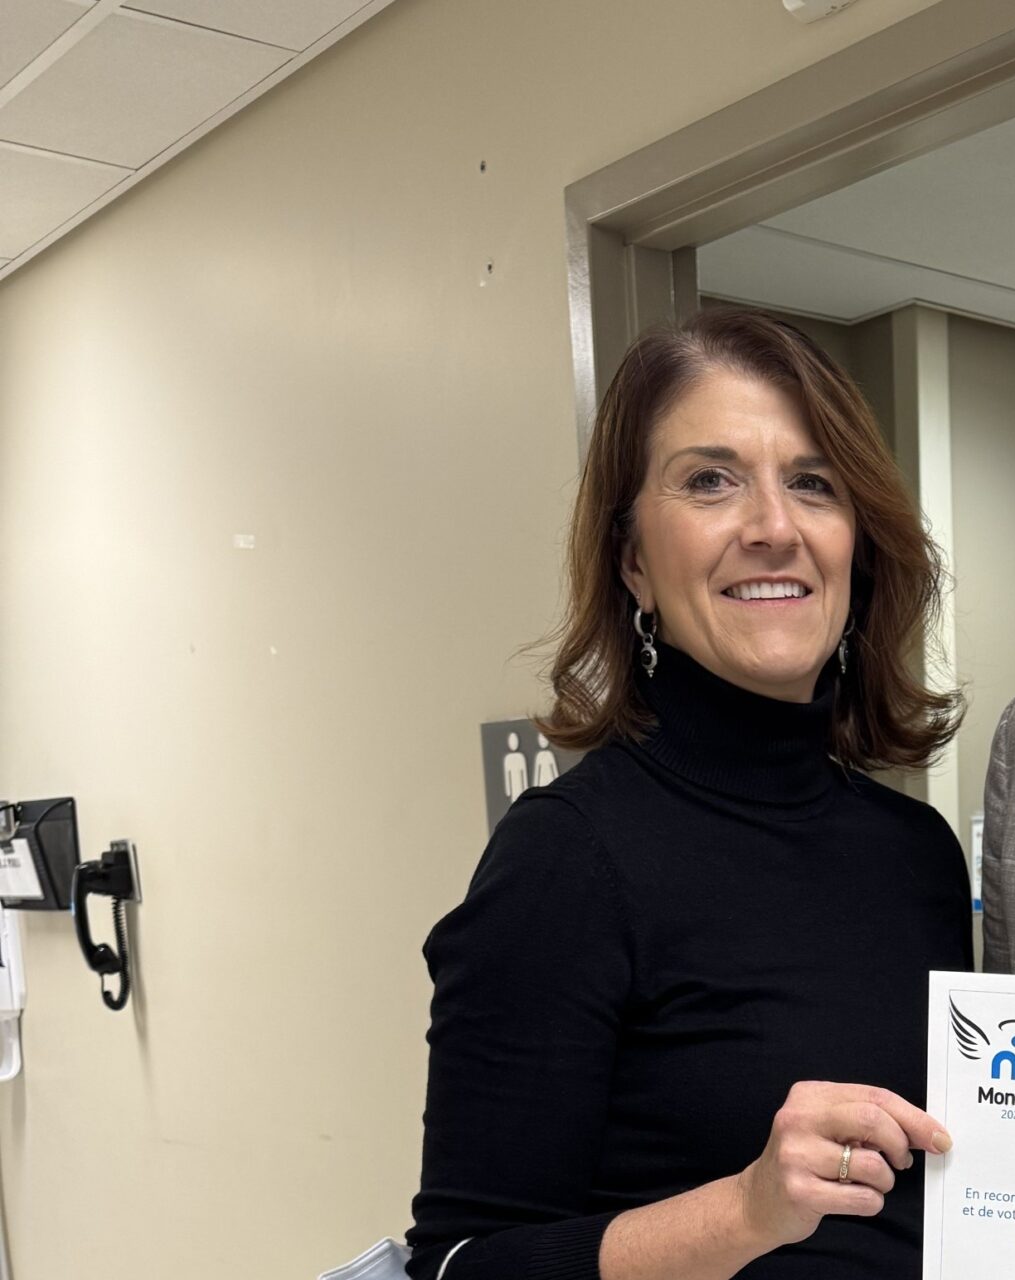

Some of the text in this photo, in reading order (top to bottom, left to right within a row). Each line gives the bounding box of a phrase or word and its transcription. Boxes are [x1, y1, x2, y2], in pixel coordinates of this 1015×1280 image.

[965, 1187, 980, 1200] En
[962, 1206, 975, 1217] et
[978, 1206, 994, 1218] de
